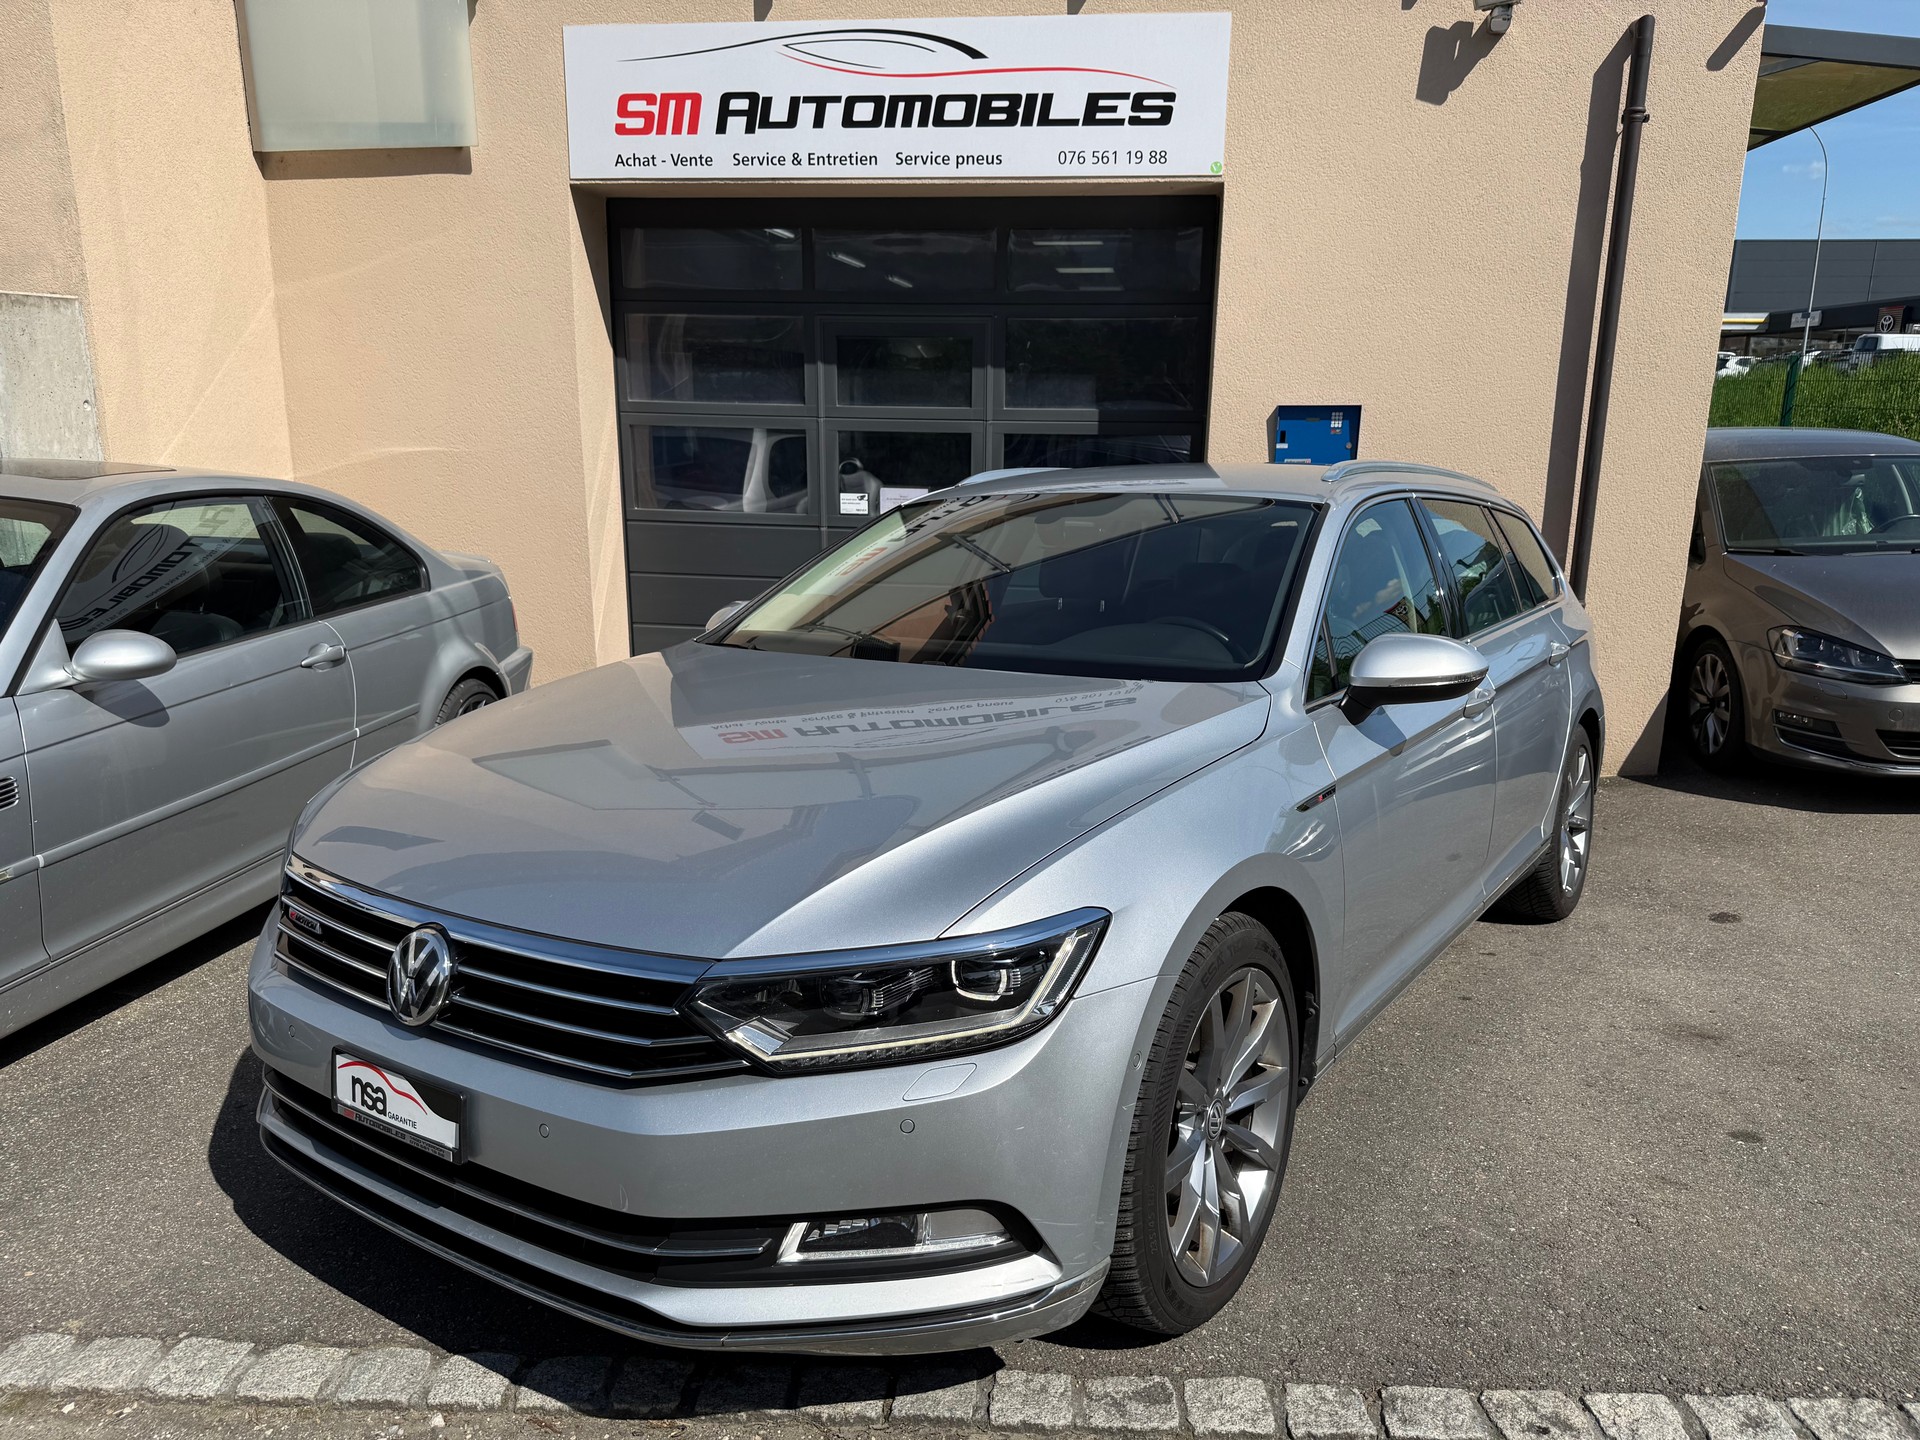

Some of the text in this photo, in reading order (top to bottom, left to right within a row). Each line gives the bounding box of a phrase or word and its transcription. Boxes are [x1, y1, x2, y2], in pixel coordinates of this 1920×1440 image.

[614, 91, 1177, 136] SM AUTOMOBILES
[614, 153, 657, 167] Achat
[671, 153, 714, 167] Vente
[733, 151, 878, 167] Service & Entretien
[895, 151, 1003, 170] Service pneus
[1058, 150, 1168, 165] 076 561 19 88
[351, 1075, 388, 1117] nsa
[387, 1111, 418, 1130] GARANTIE
